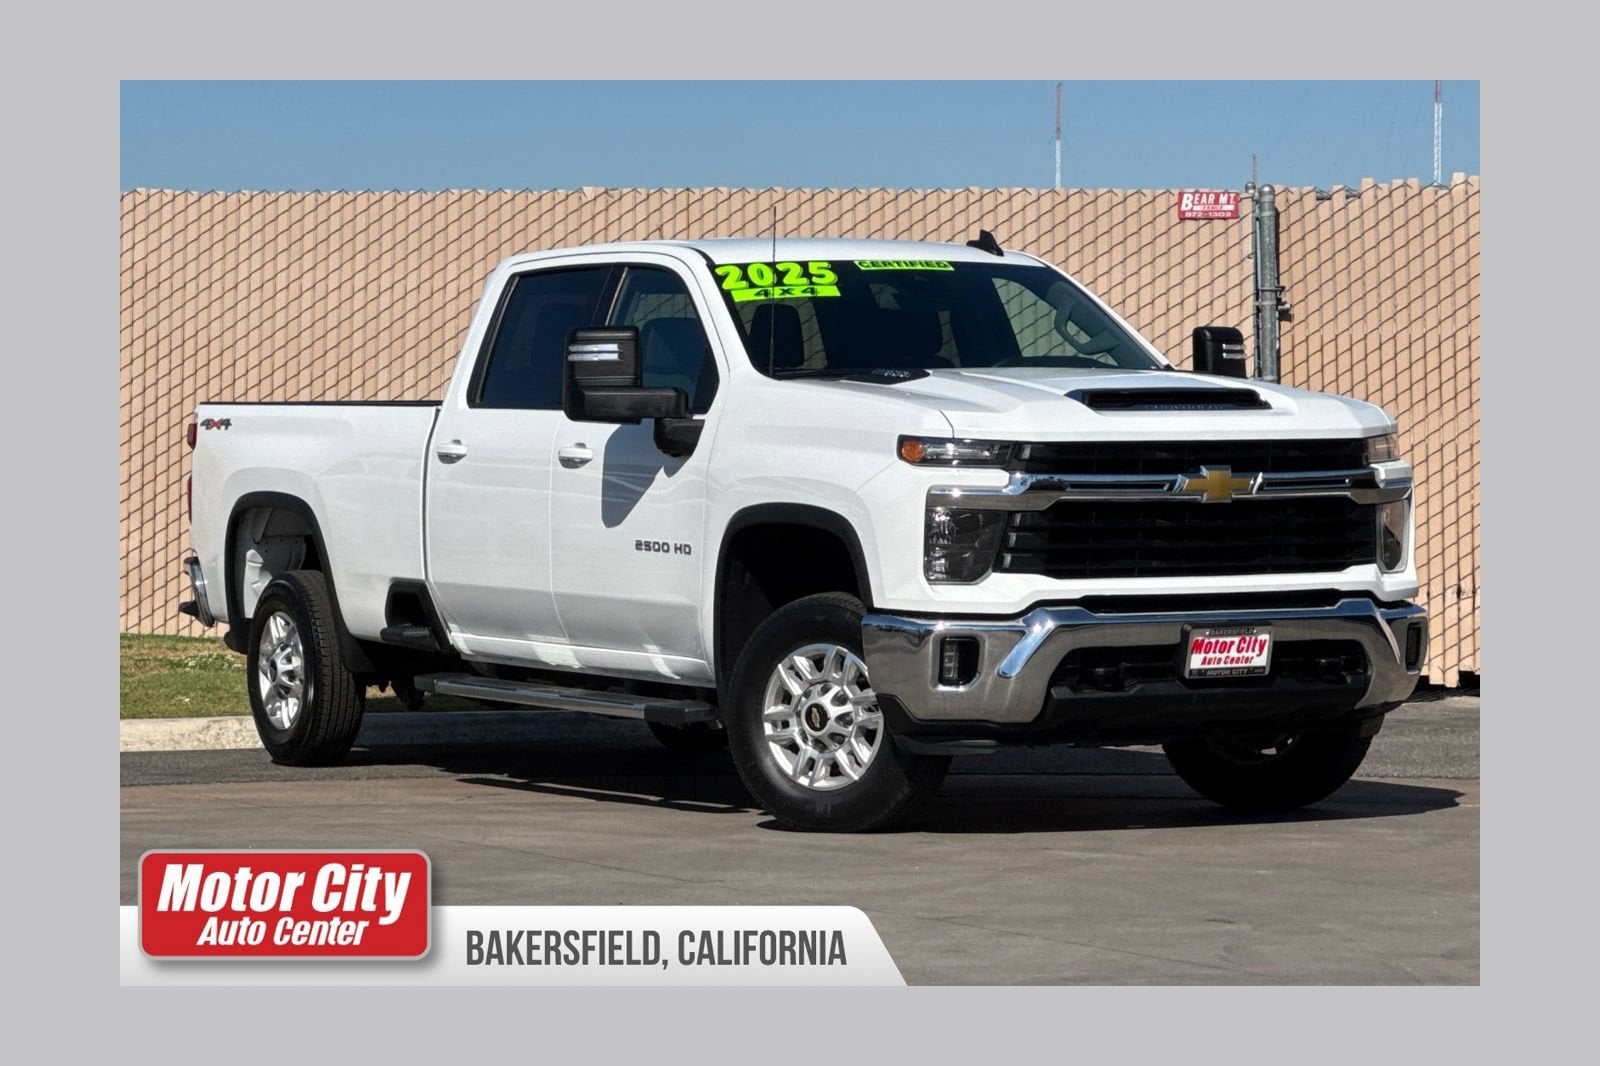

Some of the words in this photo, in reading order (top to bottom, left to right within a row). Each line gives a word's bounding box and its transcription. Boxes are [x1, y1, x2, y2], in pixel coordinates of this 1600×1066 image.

[1181, 193, 1216, 211] BEAR
[858, 260, 949, 269] CERTIFIED
[714, 261, 838, 290] 2025
[635, 540, 670, 553] 2500
[674, 543, 692, 556] HD
[1191, 638, 1235, 655] Motor
[1236, 635, 1267, 657] City
[1201, 655, 1222, 666] Auto
[1223, 655, 1254, 665] Center
